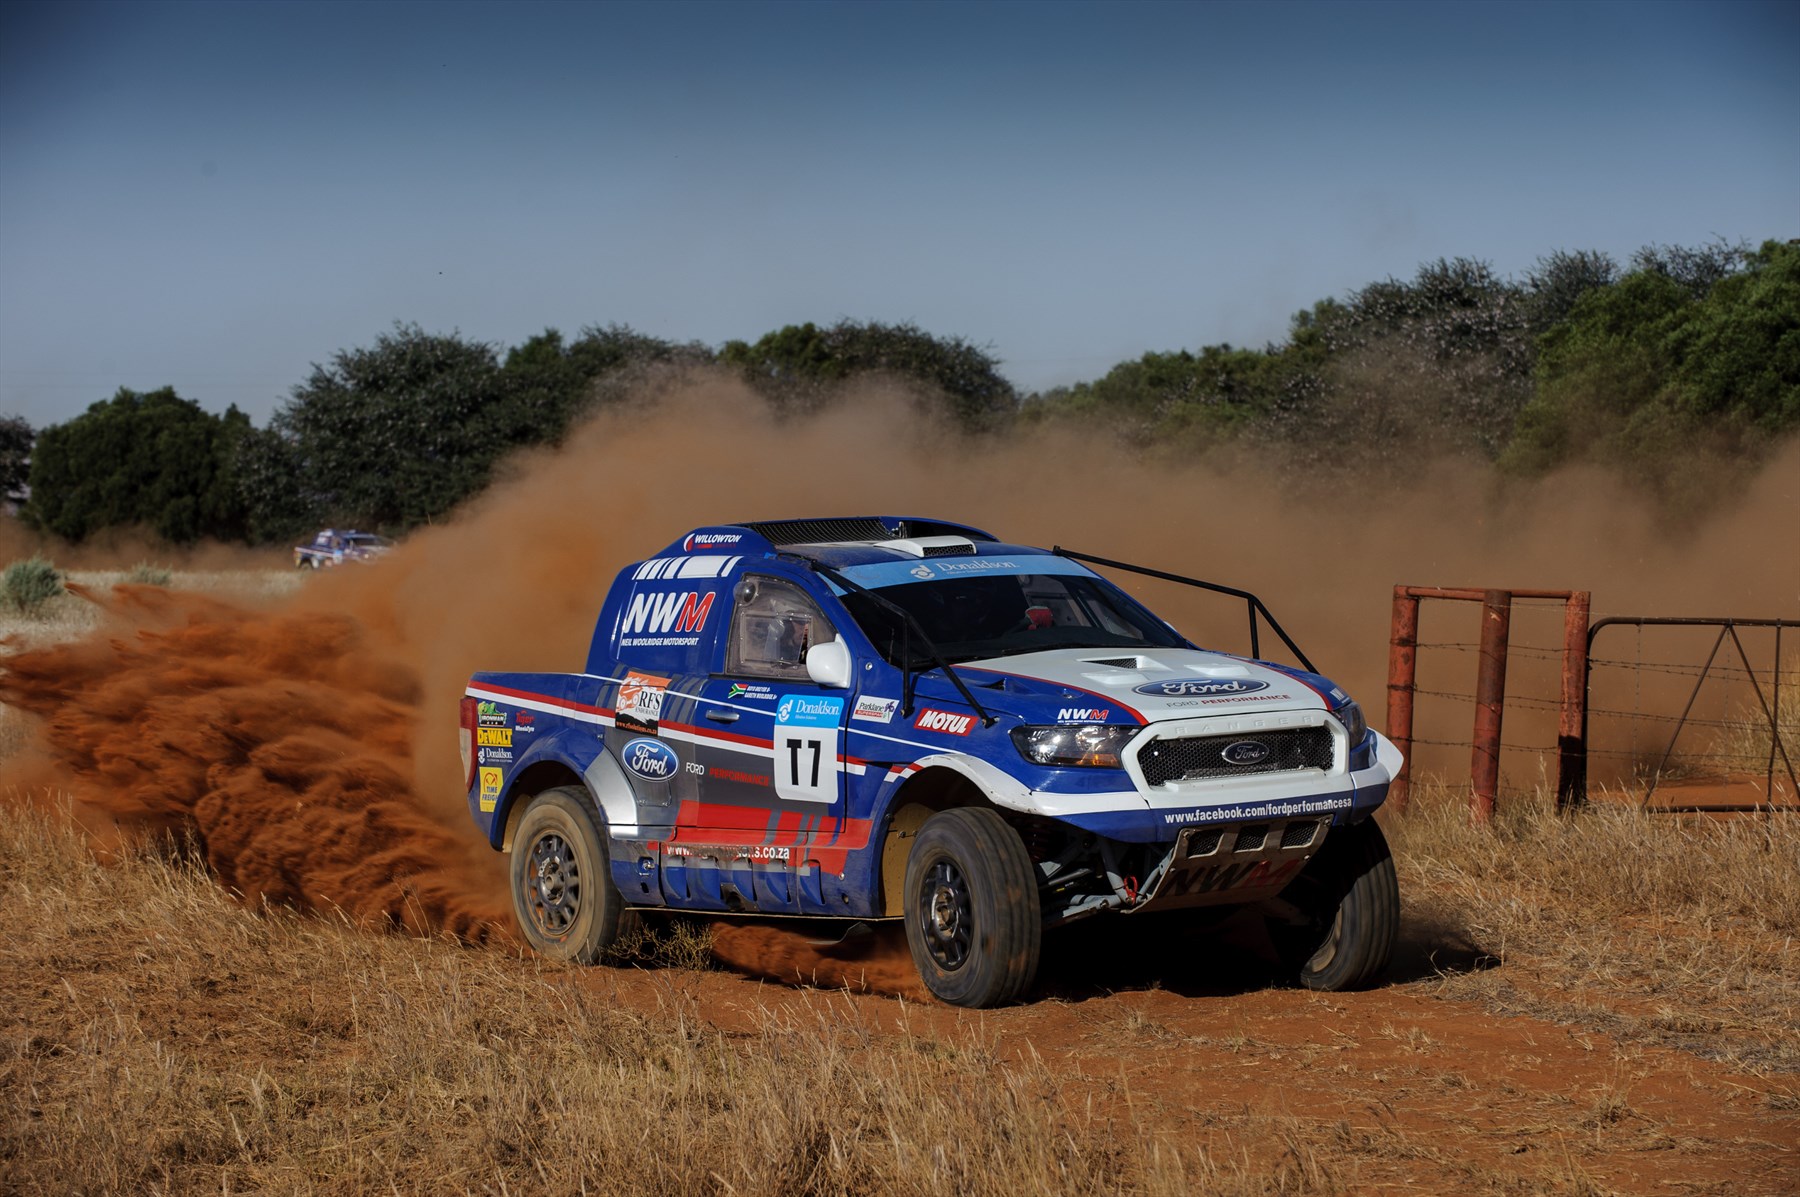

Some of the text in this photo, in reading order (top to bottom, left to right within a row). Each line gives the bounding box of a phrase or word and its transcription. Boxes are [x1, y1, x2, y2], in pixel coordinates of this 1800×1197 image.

[695, 534, 742, 543] WILLOWTON
[623, 592, 716, 633] NWM
[663, 637, 699, 646] MOTORSPORT
[1161, 680, 1246, 695] Ford
[639, 691, 662, 710] RFS
[859, 702, 885, 712] Parklane
[1166, 694, 1291, 708] FORD PERFORMANCE
[918, 710, 971, 733] MOTUL
[1057, 709, 1109, 720] NWM
[1175, 716, 1314, 734] RANGER
[632, 744, 667, 775] Ford
[1234, 745, 1261, 760] Ford
[787, 739, 821, 787] T7
[685, 762, 769, 786] FORD PERFORMANCE
[1165, 798, 1352, 824] www.facebook.com/fordperformancesa
[1159, 859, 1299, 896] NWM
